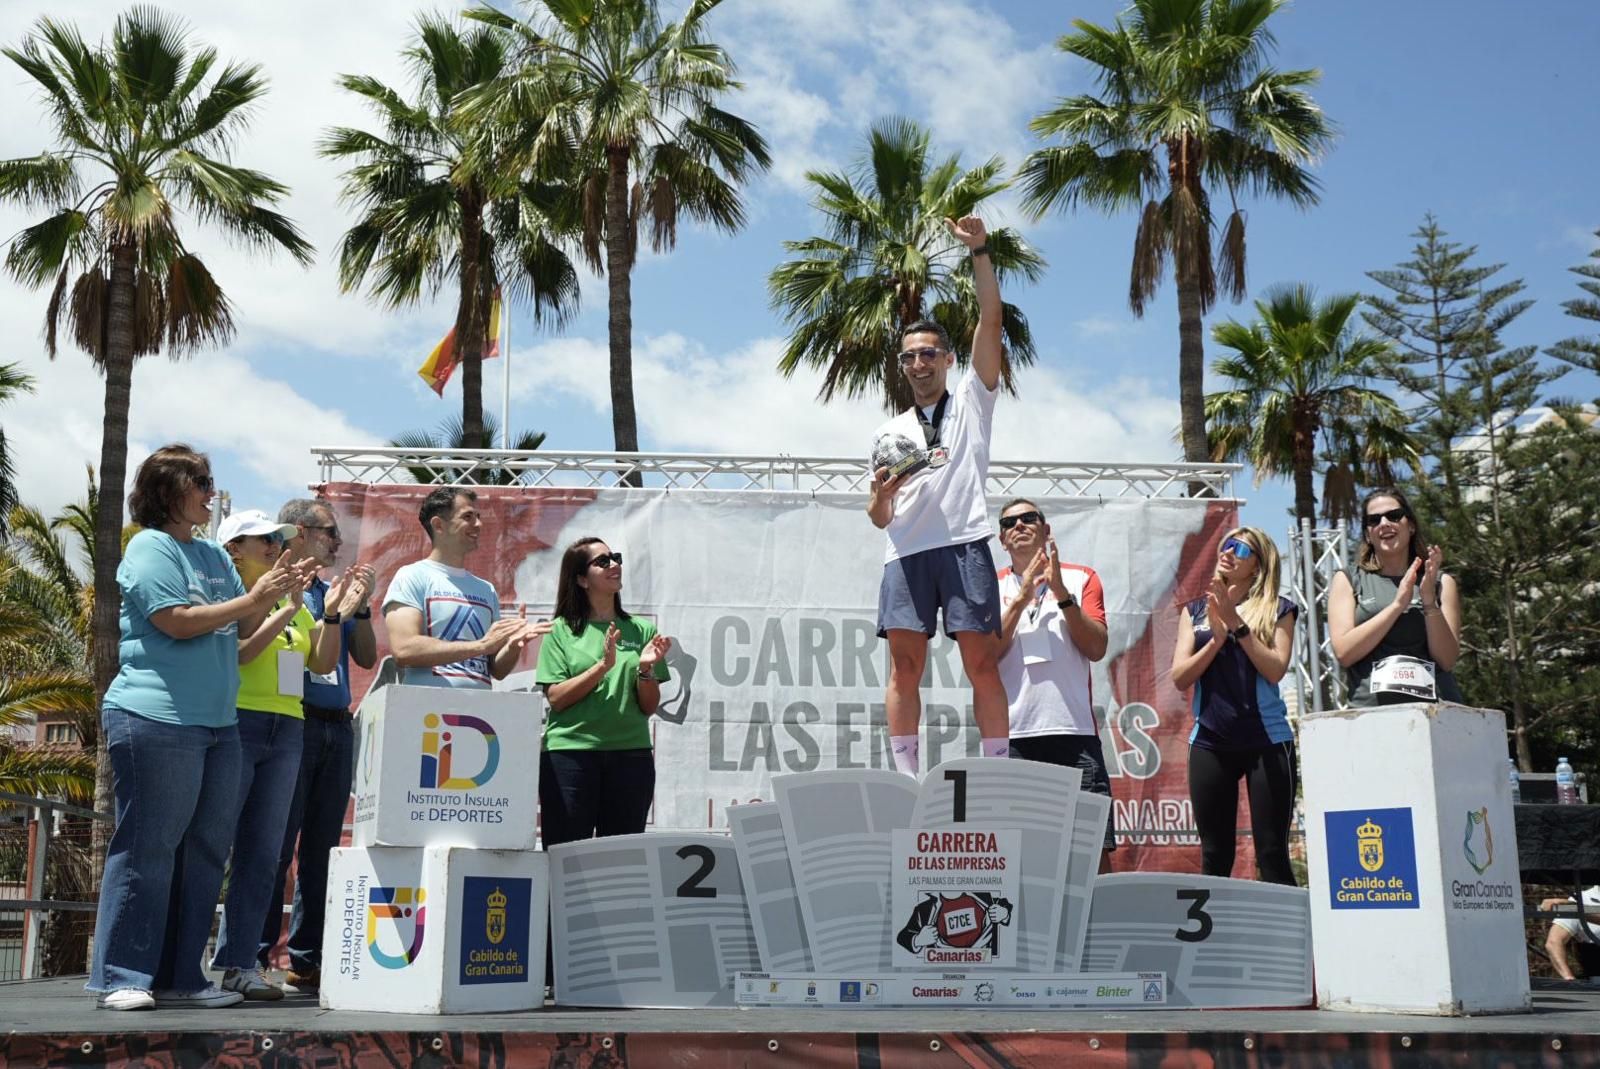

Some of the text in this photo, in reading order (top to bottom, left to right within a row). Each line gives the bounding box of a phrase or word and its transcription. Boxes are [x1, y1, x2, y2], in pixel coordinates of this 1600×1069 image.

[710, 616, 974, 688] CARRR
[708, 700, 821, 772] LAS
[407, 790, 509, 807] INSTITUTO INSULAR
[944, 770, 967, 823] 1
[410, 808, 503, 824] DE DEPORTES
[917, 832, 998, 853] CARRERA
[675, 844, 717, 898] 2
[908, 857, 1006, 870] DE LAS EMPRESAS
[908, 876, 921, 885] LAS
[921, 876, 947, 885] PALMAS
[957, 876, 974, 885] GRAN
[975, 876, 1003, 885] CANARIA
[1341, 876, 1403, 889] Cabildo de
[1336, 889, 1413, 902] Gran Canaria
[948, 914, 972, 930] C7CE
[1175, 889, 1213, 943] 3
[340, 880, 355, 975] DE DEPORTES
[351, 875, 369, 980] INSTITUTO INSULAR
[470, 948, 518, 962] Cabildo de
[465, 963, 523, 976] Gran Canaria
[1056, 987, 1088, 997] cajamar
[1096, 986, 1133, 998] Binter
